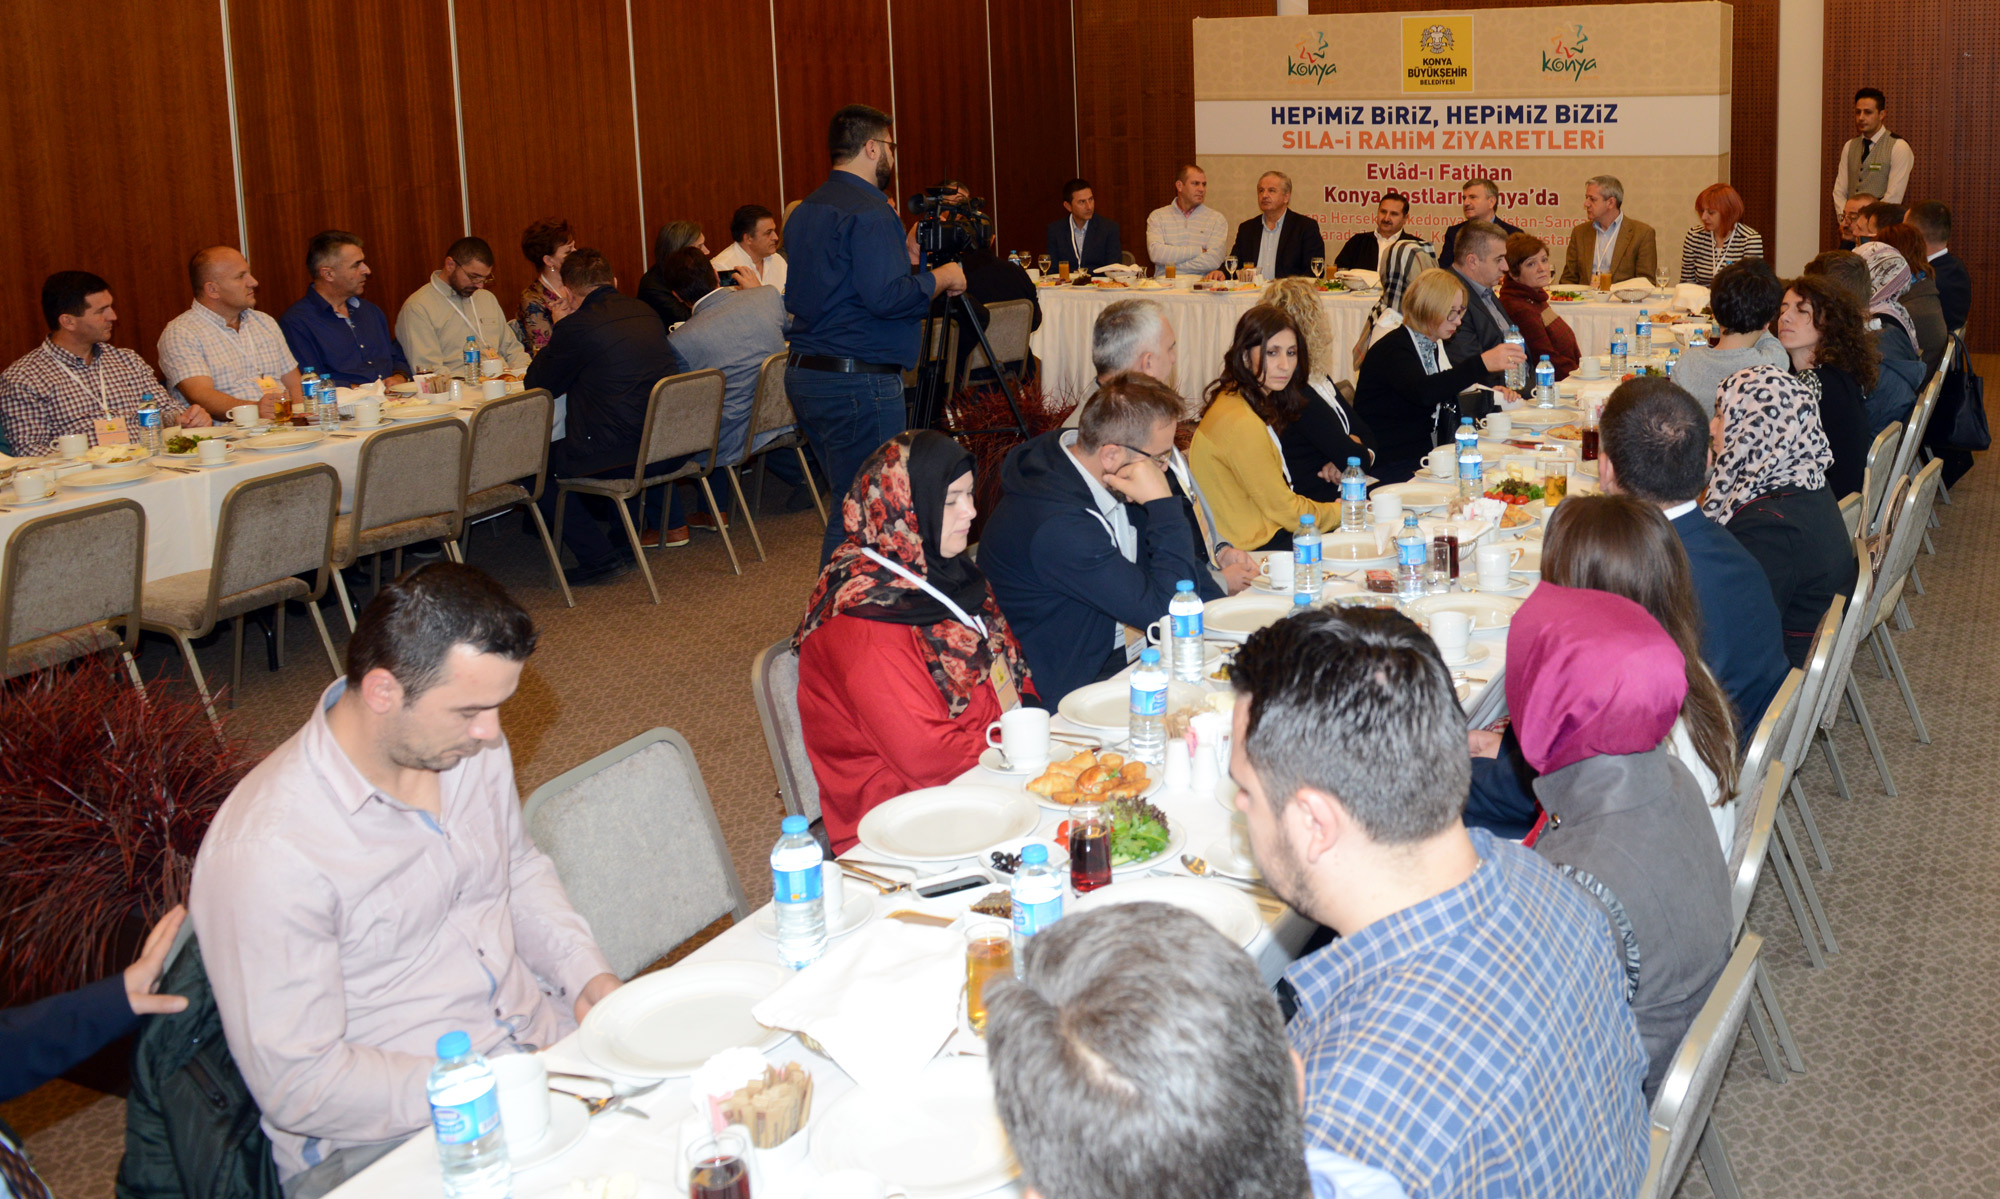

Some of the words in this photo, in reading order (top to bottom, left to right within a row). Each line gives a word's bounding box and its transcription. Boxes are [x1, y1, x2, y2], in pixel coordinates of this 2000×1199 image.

[1422, 57, 1452, 66] KONYA
[1407, 66, 1468, 78] BÜYÜKŞEHİR
[1420, 78, 1456, 86] BELEDİYESİ
[1366, 162, 1434, 180] Evlâd-ı
[1439, 163, 1512, 181] Fatihan
[1324, 187, 1380, 207] Konya
[1497, 188, 1559, 209] nya’da
